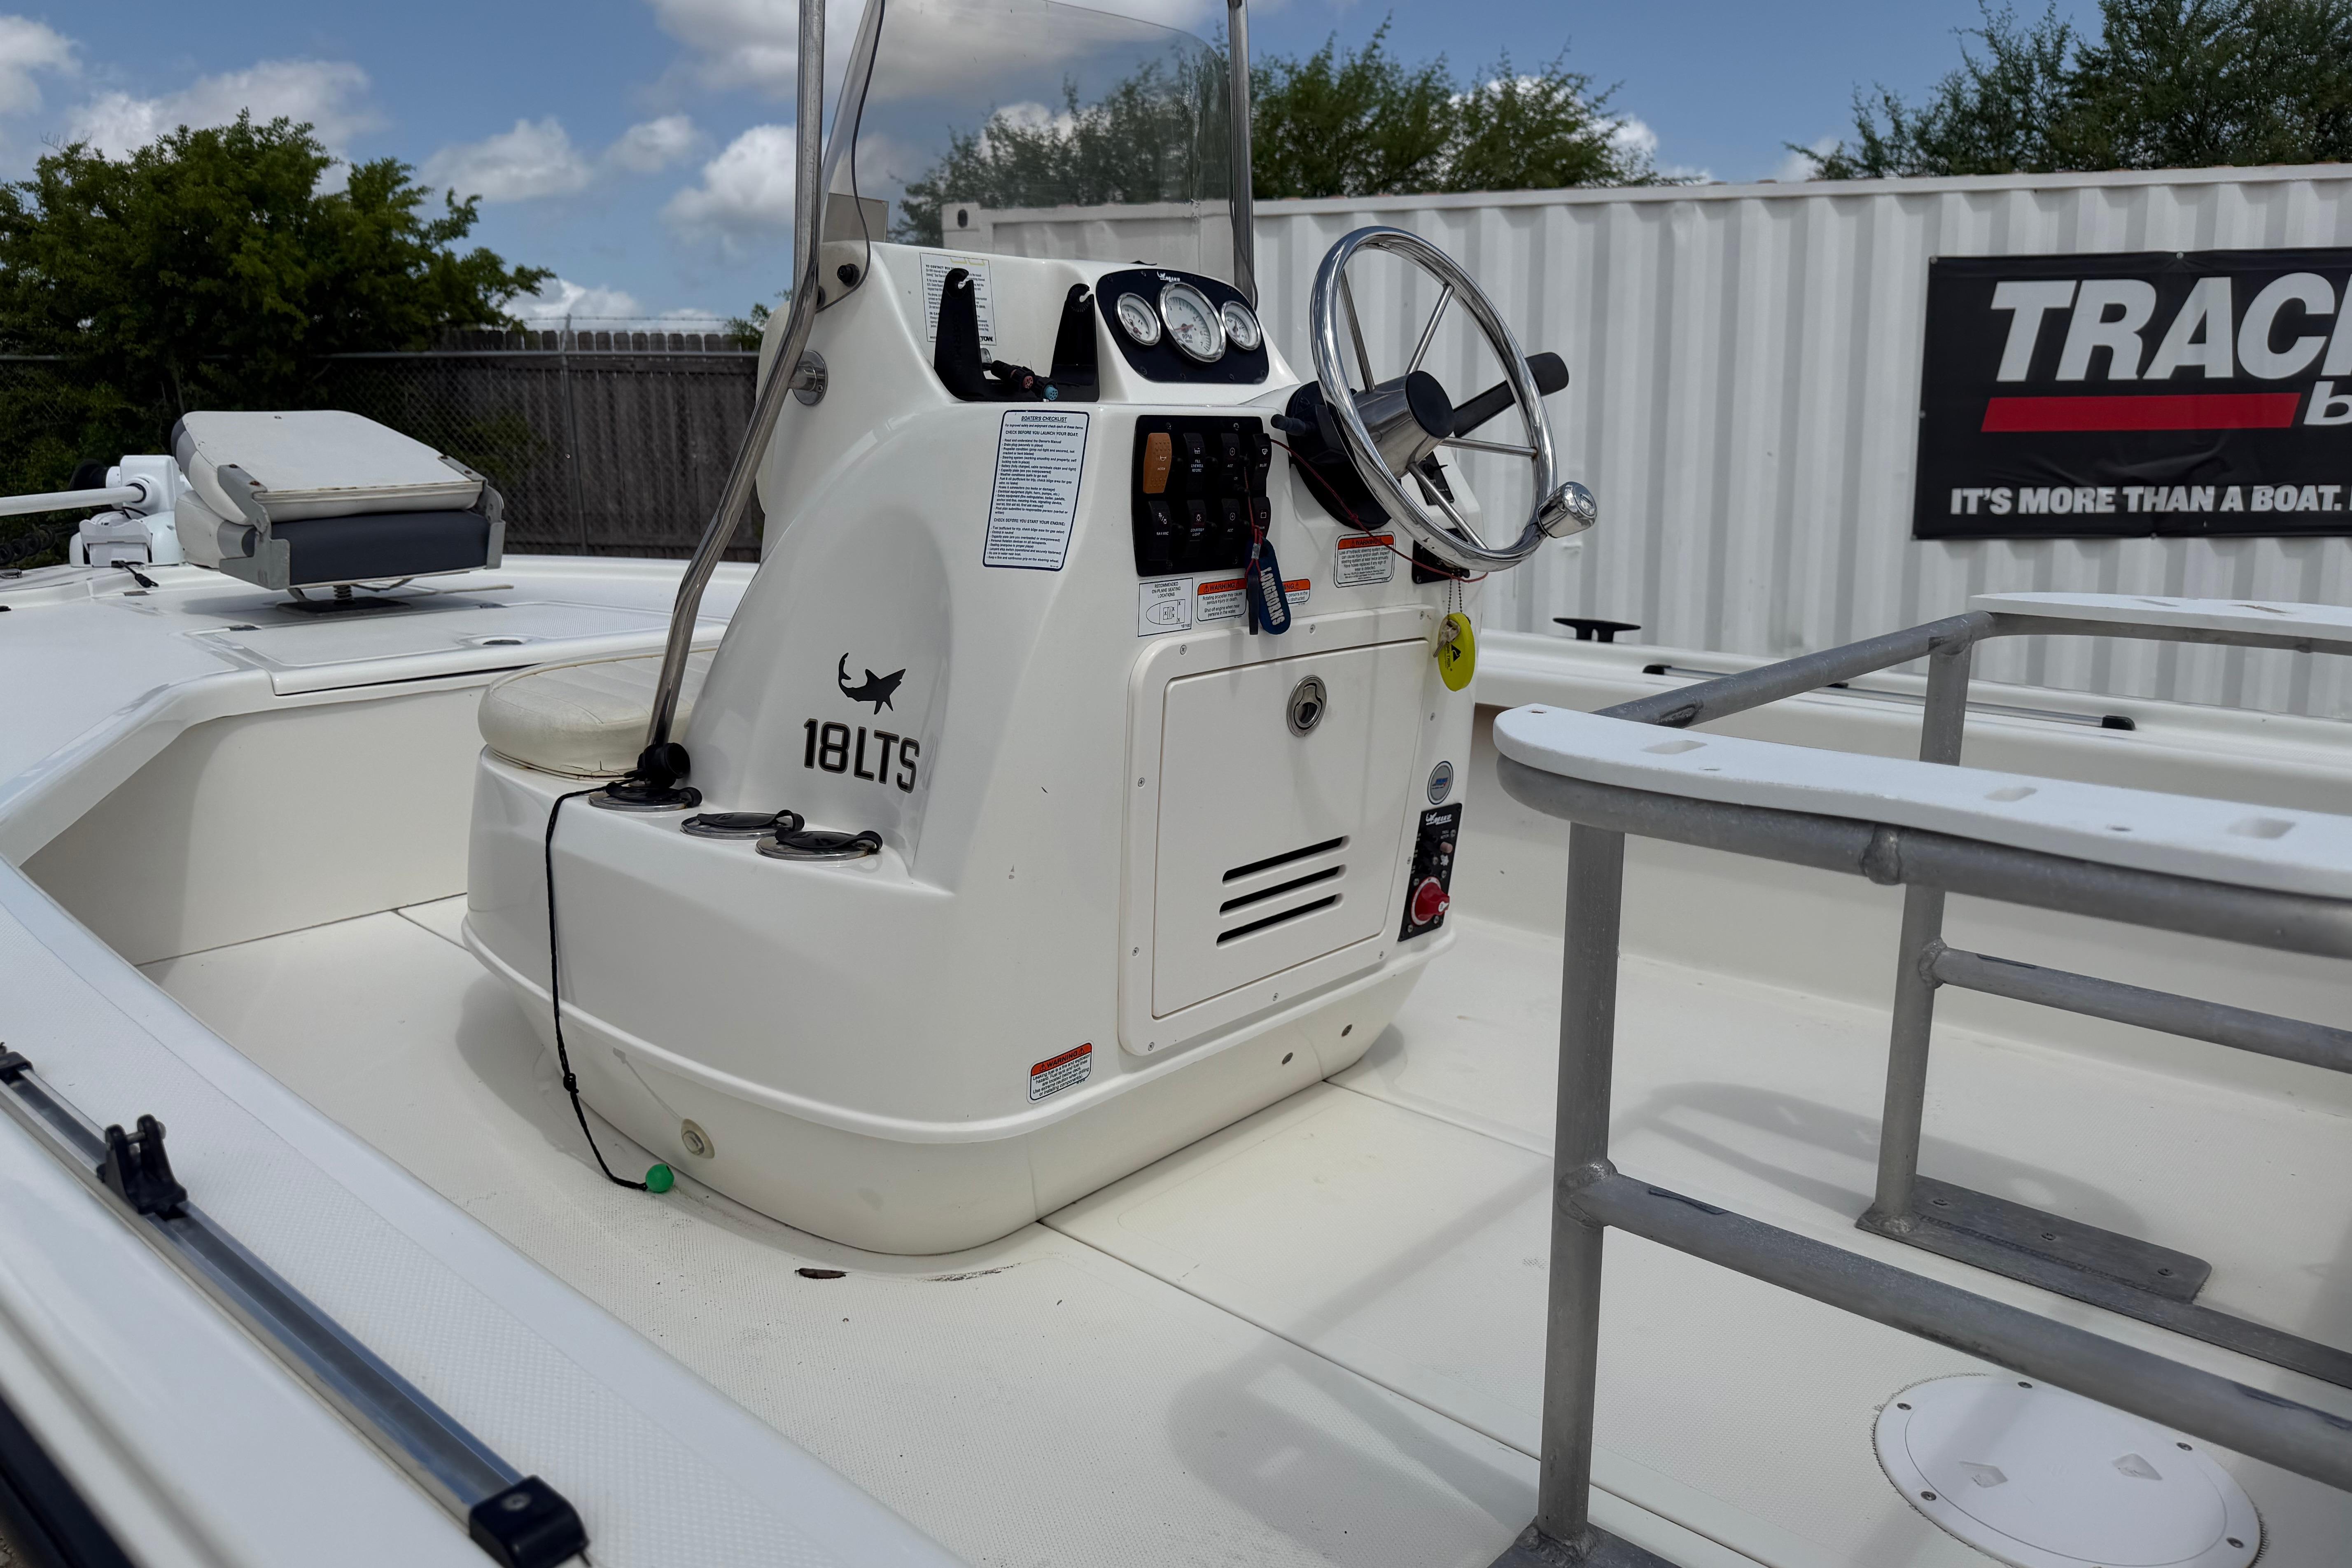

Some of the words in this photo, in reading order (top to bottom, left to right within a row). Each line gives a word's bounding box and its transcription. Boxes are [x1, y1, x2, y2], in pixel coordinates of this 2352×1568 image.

[1951, 488, 2012, 515] IT'S
[2018, 486, 2116, 515] MORE
[2123, 485, 2215, 513] THAN
[2220, 486, 2243, 512] A
[2250, 484, 2342, 512] BOAT.
[1210, 582, 1235, 591] WARNING
[1260, 567, 1285, 625] LONGHORNS
[803, 718, 920, 793] 18LTS
[1047, 1050, 1078, 1068] WARNING
[1033, 1072, 1048, 1082] Leaking
